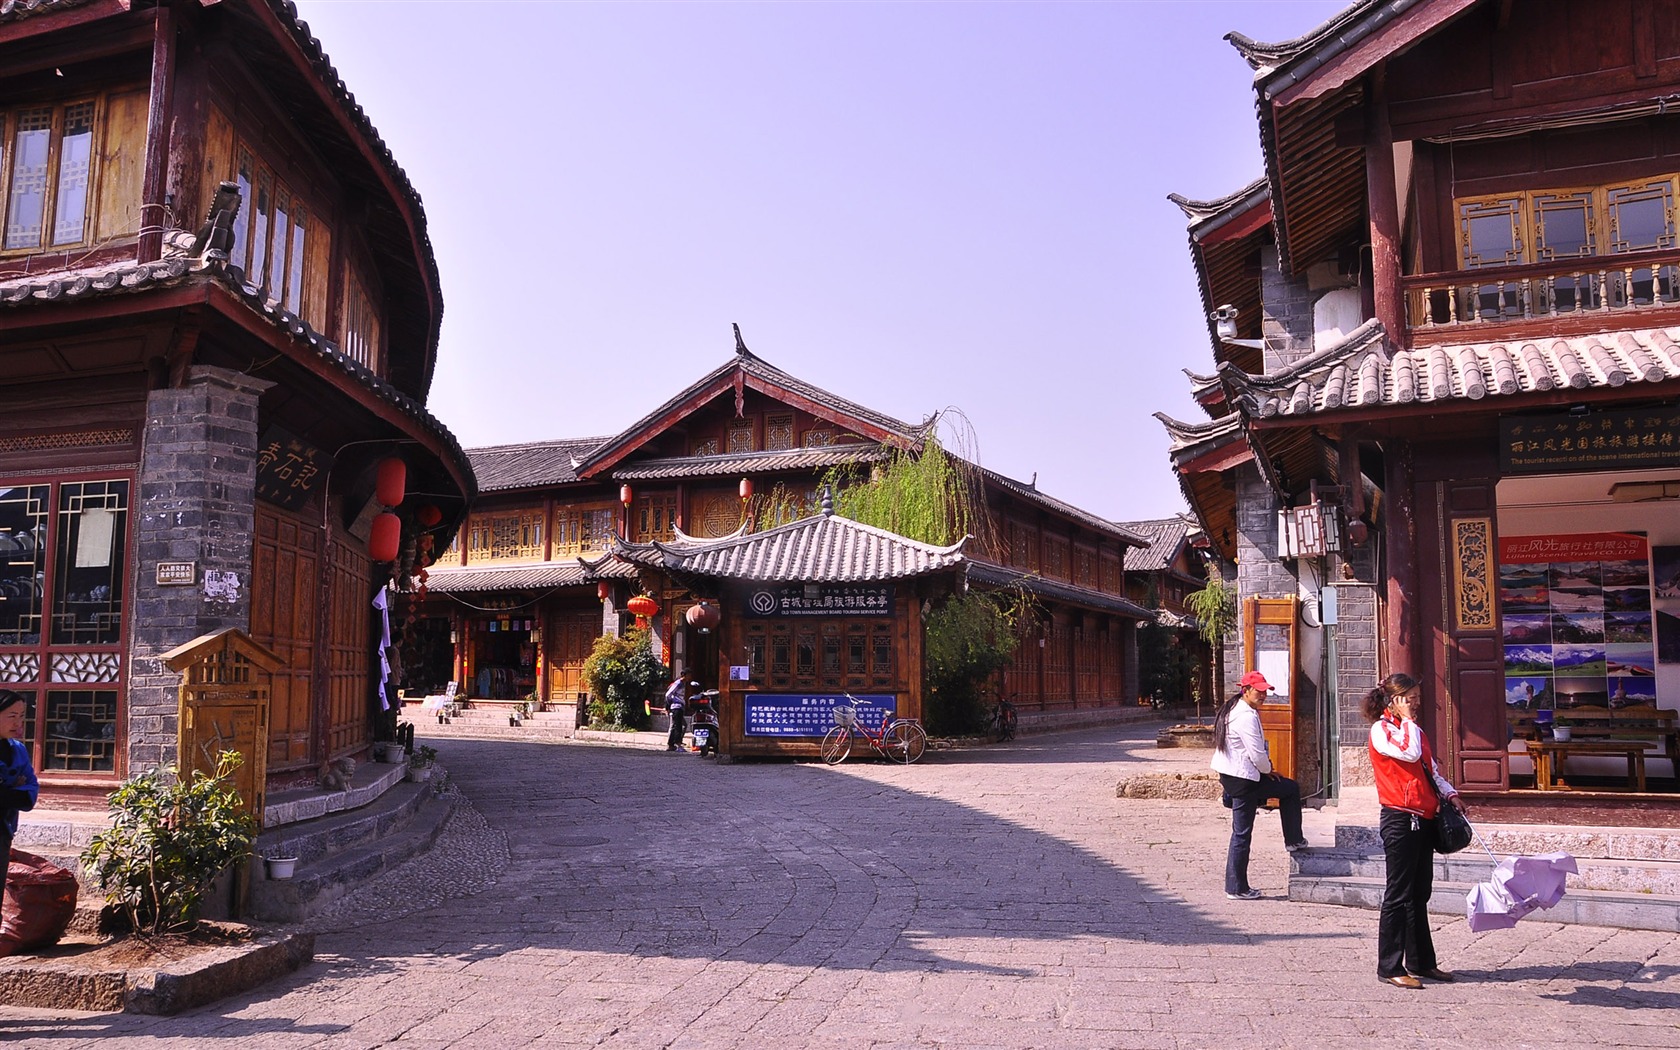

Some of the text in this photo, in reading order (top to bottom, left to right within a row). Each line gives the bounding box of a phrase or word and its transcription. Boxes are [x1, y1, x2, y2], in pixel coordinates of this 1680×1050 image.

[1510, 431, 1680, 453] 丽江风光国旅旅游接待
[1511, 457, 1523, 465] The
[1524, 456, 1545, 464] tourist
[1578, 454, 1585, 462] of
[1586, 453, 1597, 461] the
[1598, 453, 1617, 461] scene
[1506, 538, 1640, 554] 丽江风光旅行社有限公司
[780, 596, 888, 608] 古城管理局旅游服务亭
